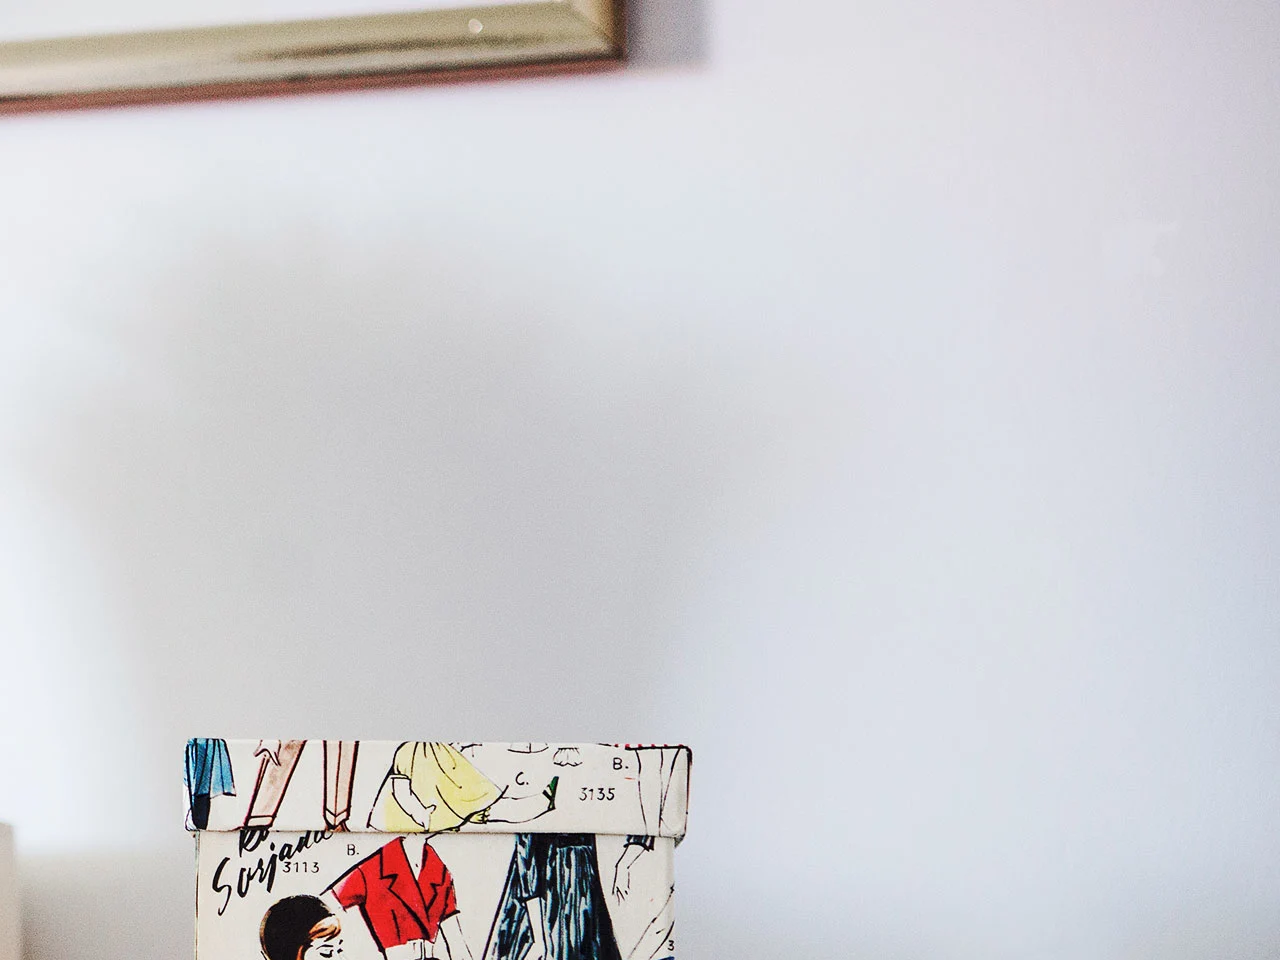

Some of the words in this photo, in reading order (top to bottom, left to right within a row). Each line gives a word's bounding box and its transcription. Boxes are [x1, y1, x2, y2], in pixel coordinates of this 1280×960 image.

[612, 757, 630, 770] B.
[515, 771, 530, 786] C.
[579, 787, 616, 801] 3135
[346, 843, 360, 856] B.
[282, 861, 320, 873] 3113
